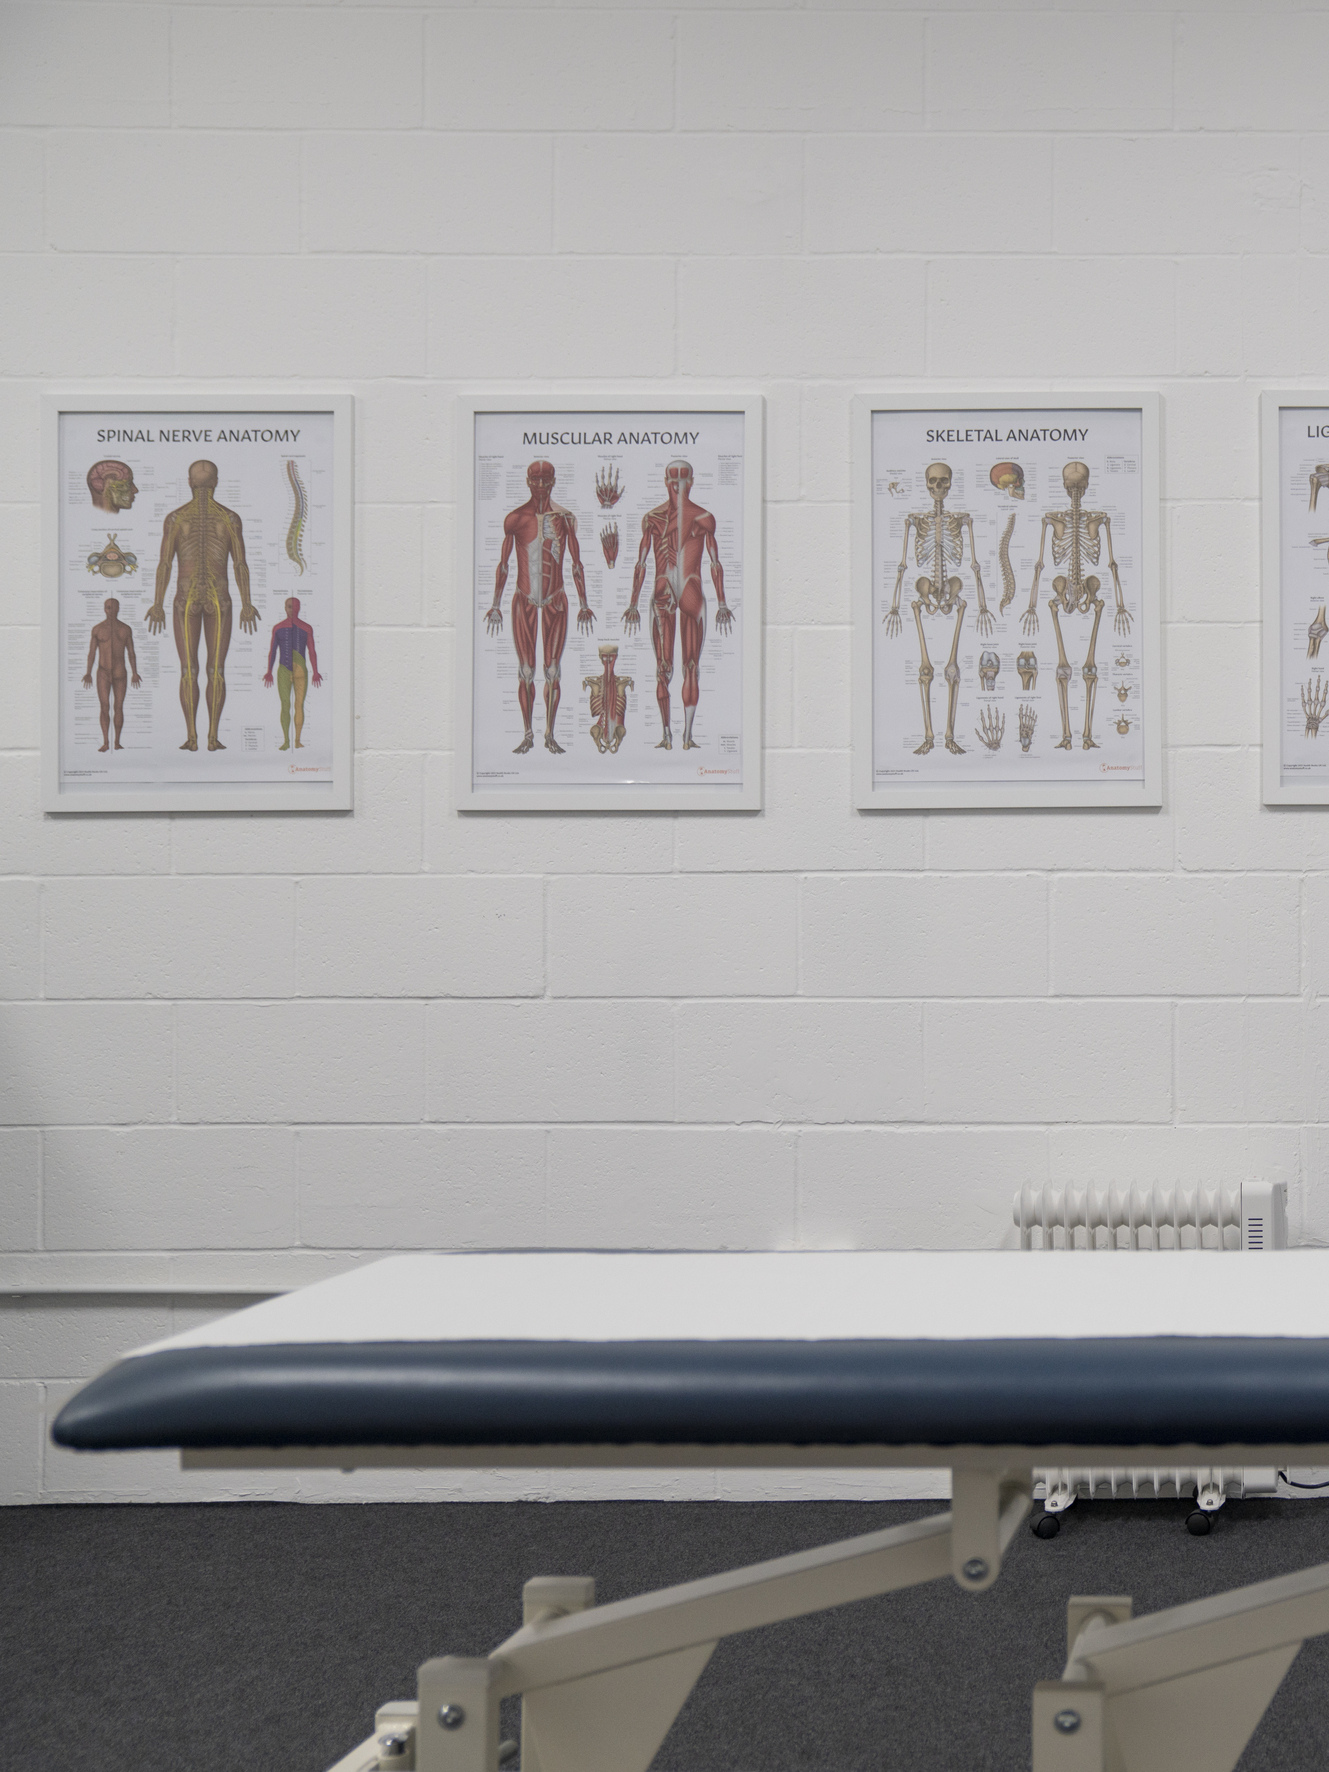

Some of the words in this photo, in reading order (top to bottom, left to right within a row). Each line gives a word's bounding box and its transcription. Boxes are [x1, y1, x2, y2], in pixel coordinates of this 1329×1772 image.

[96, 429, 155, 443] SPINAL
[159, 429, 213, 443] NERVE
[216, 429, 301, 443] ANATOMY
[522, 431, 613, 445] MUSCULAR
[617, 431, 700, 445] ANATOMY
[926, 428, 1003, 443] SKELETAL
[1006, 428, 1089, 443] ANATOMY
